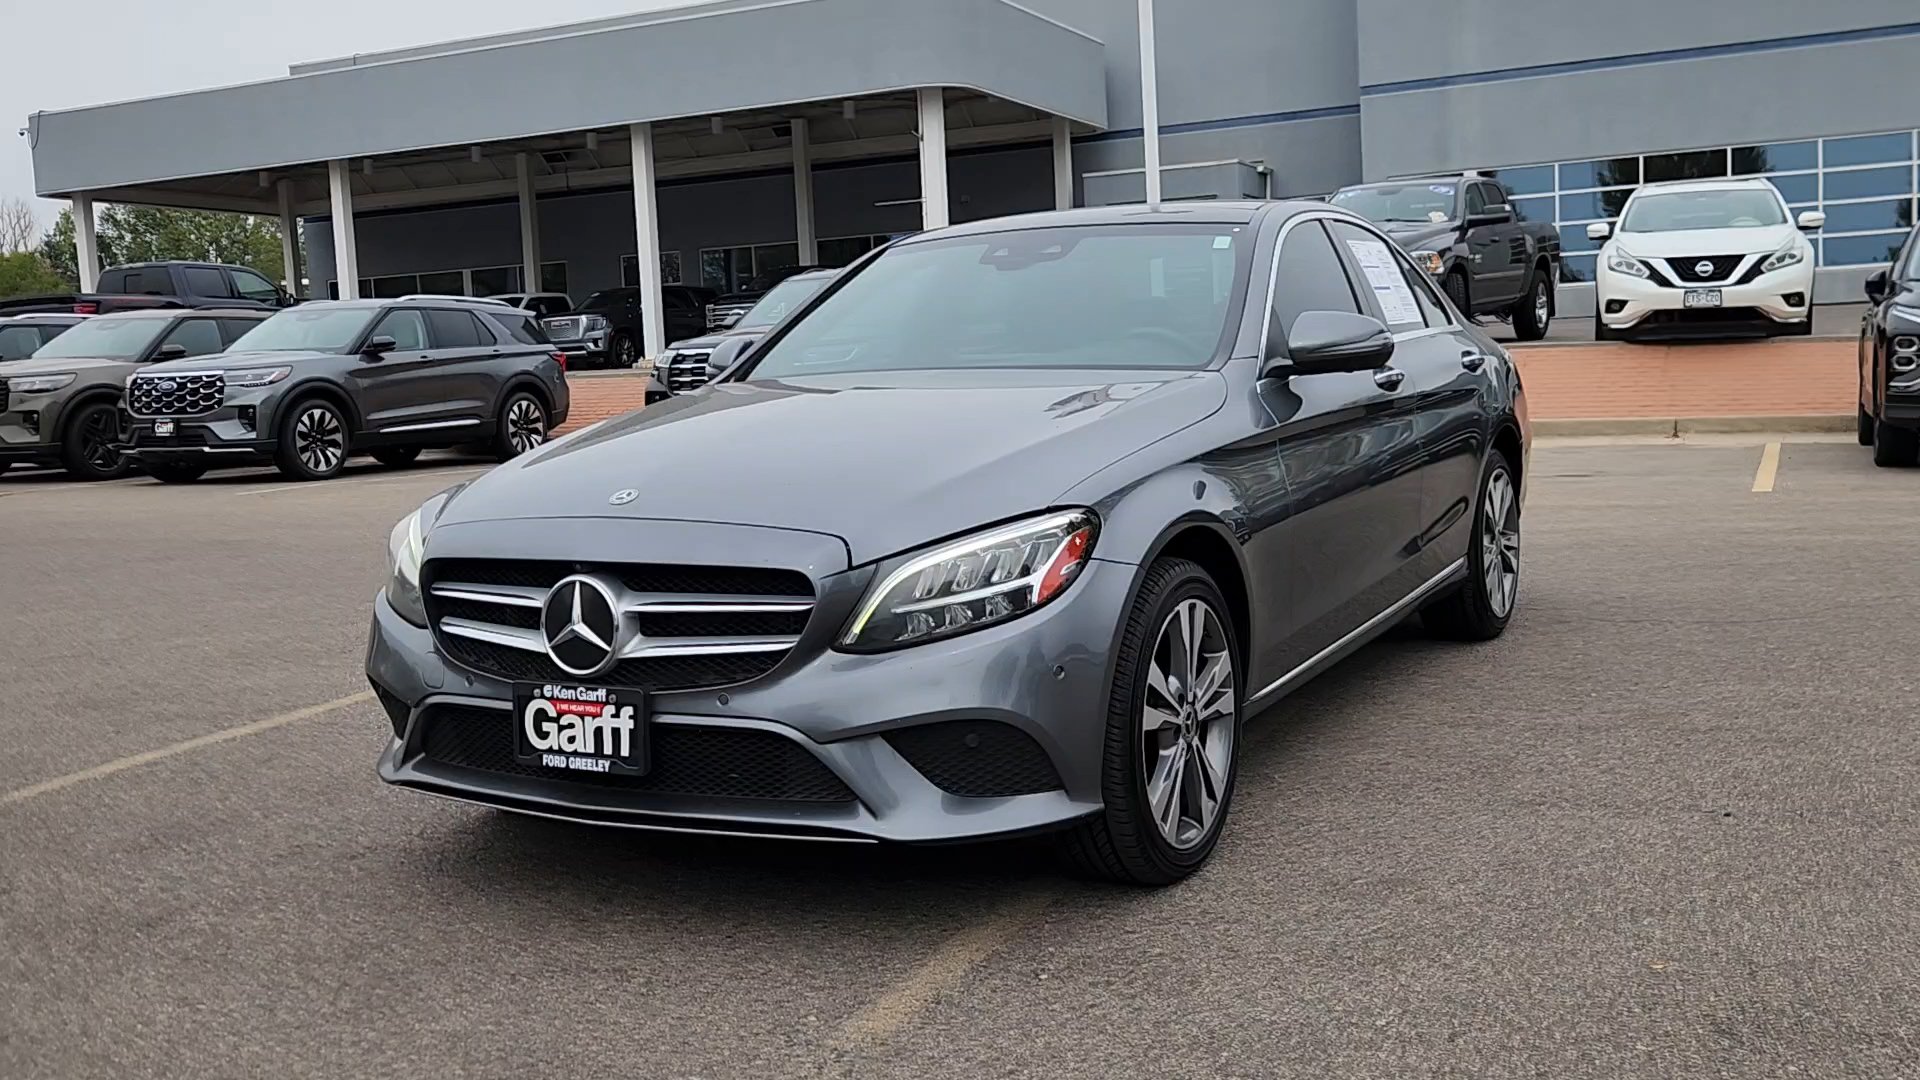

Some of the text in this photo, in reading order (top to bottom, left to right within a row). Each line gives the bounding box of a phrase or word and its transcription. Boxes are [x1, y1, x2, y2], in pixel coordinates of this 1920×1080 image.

[553, 685, 607, 702] Ken Garff
[560, 703, 597, 713] WE HEAR YOU
[524, 698, 635, 757] Garff
[542, 754, 611, 773] FORD GREELEY
